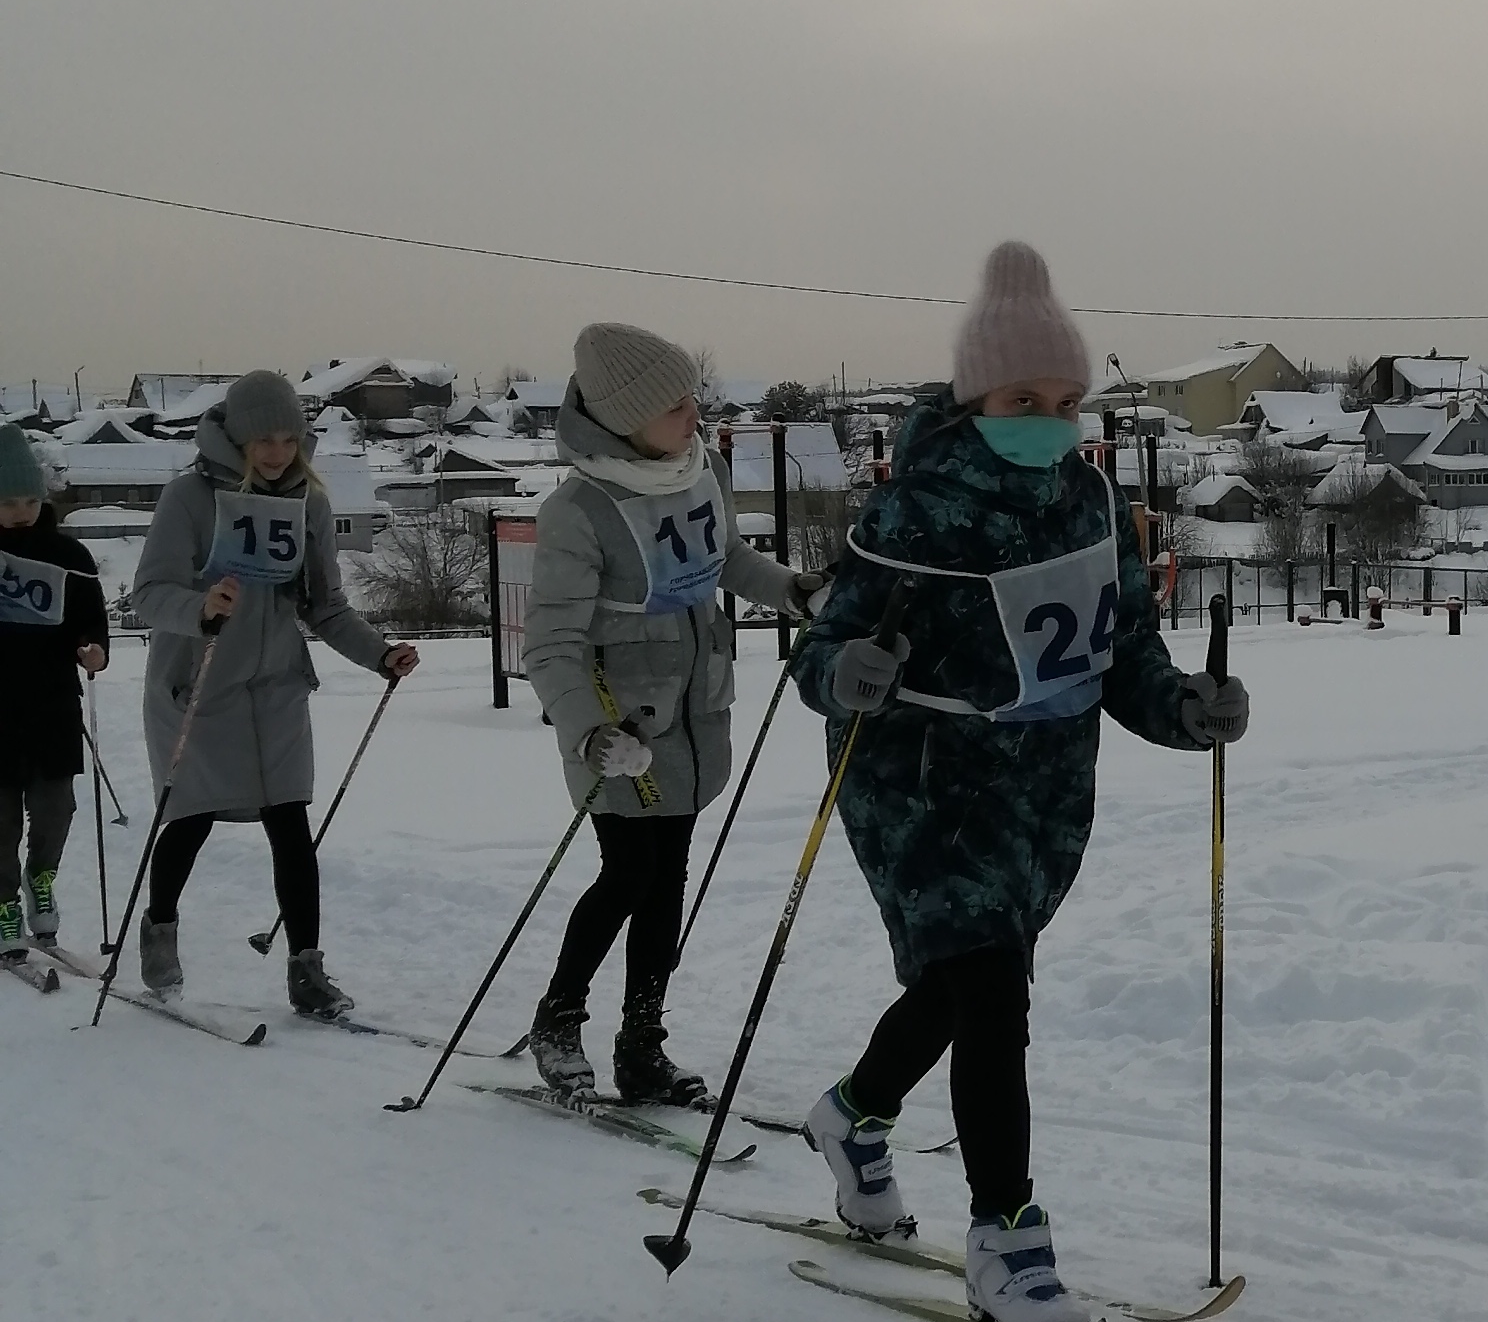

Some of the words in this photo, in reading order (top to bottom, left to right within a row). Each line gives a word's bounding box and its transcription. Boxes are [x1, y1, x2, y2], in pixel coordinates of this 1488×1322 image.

[233, 515, 297, 562] 15
[655, 500, 717, 564] 17
[1024, 580, 1116, 683] 24
